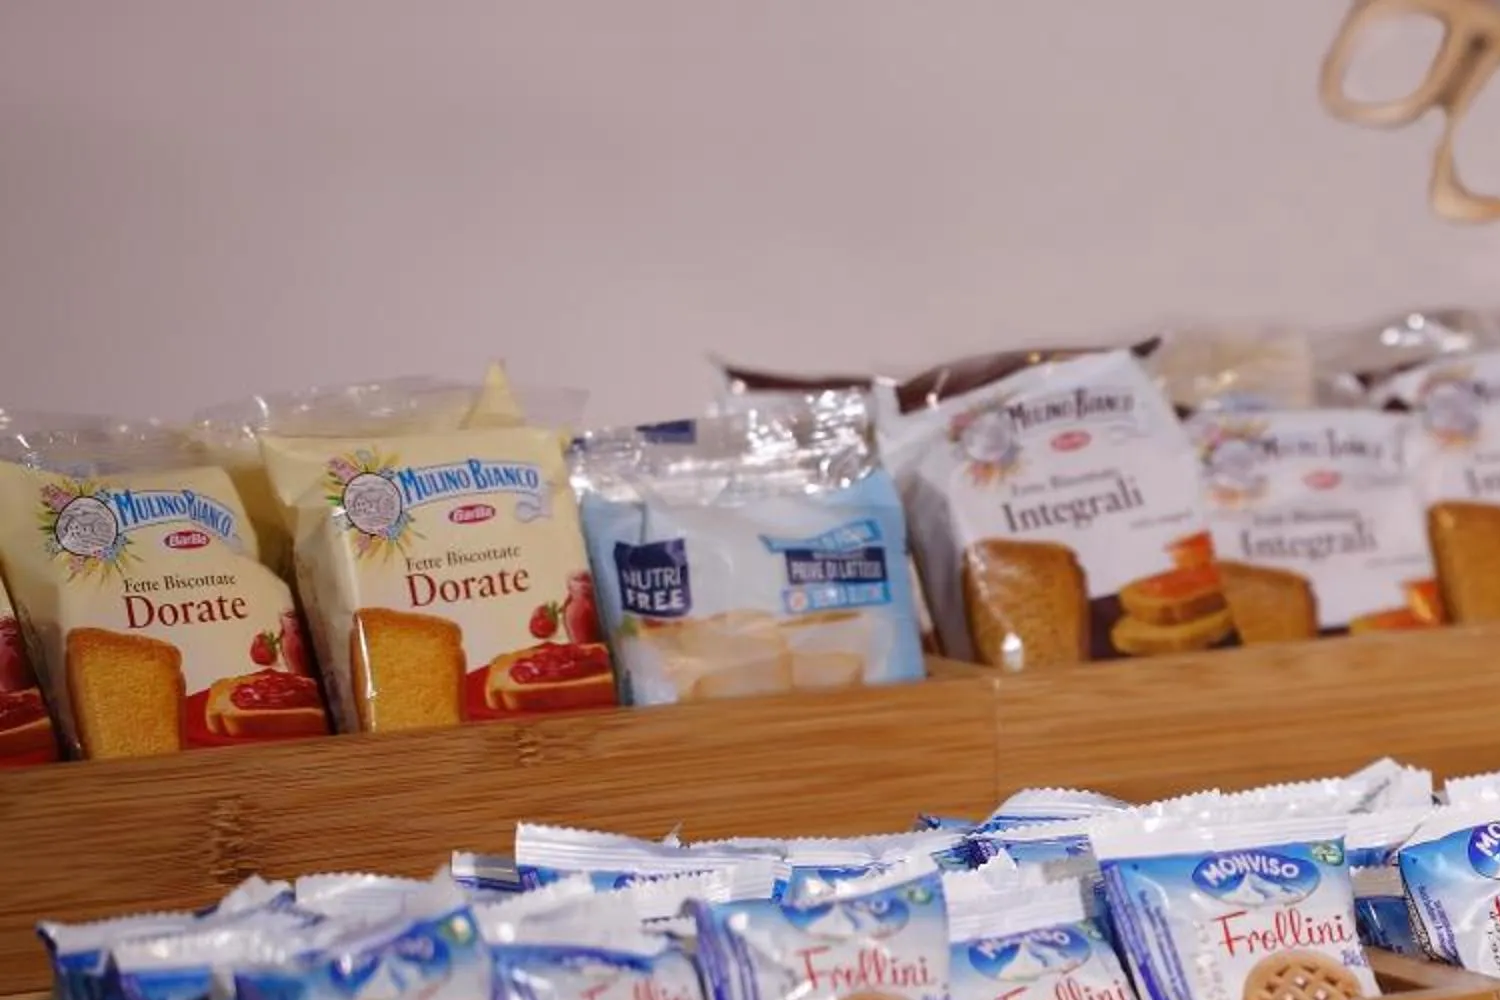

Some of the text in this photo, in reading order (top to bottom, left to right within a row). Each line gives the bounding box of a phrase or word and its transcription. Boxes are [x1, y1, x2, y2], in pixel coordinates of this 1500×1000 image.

[398, 459, 539, 503] MULINO BIANCO
[114, 489, 234, 537] MULINO BIANCO
[1001, 477, 1145, 532] Integrali
[123, 573, 237, 593] Fette Biscottate
[405, 568, 530, 608] Dorate
[622, 566, 682, 590] NUTRI
[122, 594, 248, 629] Dorate
[626, 588, 684, 609] FREE
[1202, 854, 1300, 888] MONVISO
[1212, 908, 1354, 958] Frollini
[796, 946, 937, 992] Frollini
